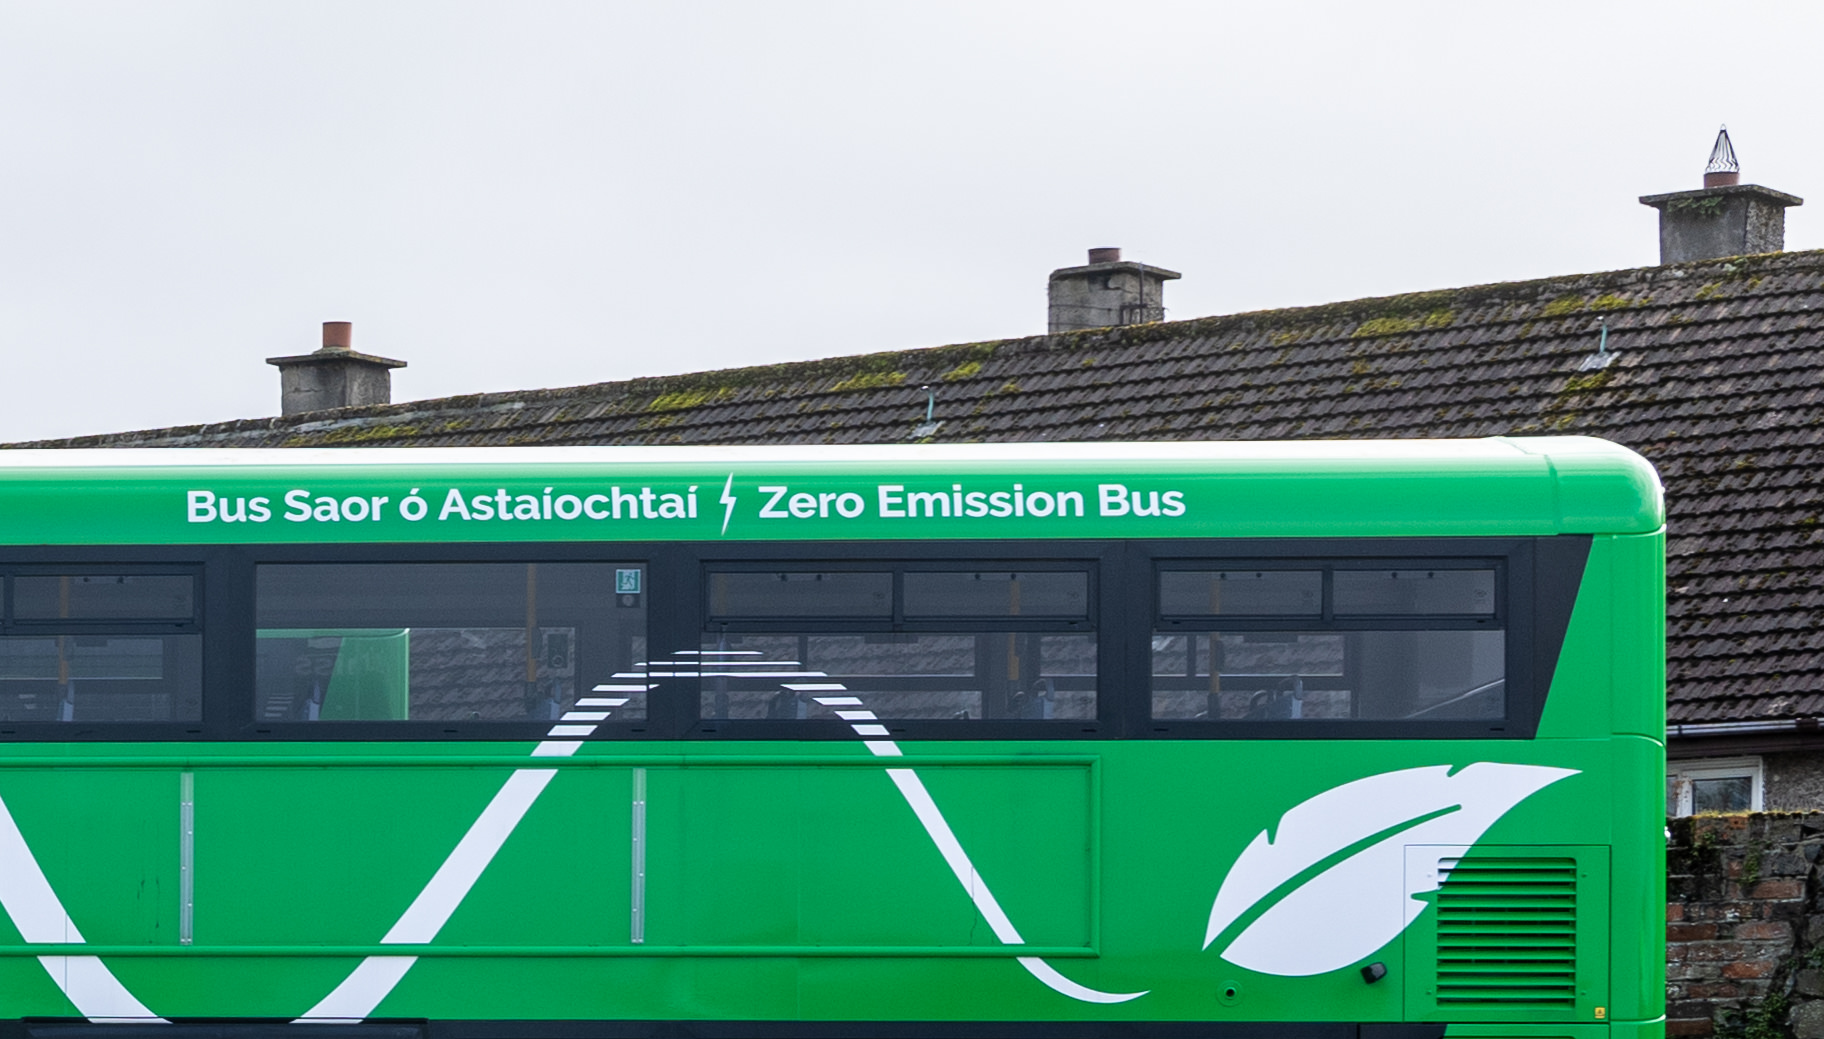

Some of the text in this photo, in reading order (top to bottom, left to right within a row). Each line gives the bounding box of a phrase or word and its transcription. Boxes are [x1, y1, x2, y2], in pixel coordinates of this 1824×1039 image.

[188, 485, 698, 522] Bus Saor ó Astaíochtaí
[759, 484, 1185, 518] Zero Emission Bus
